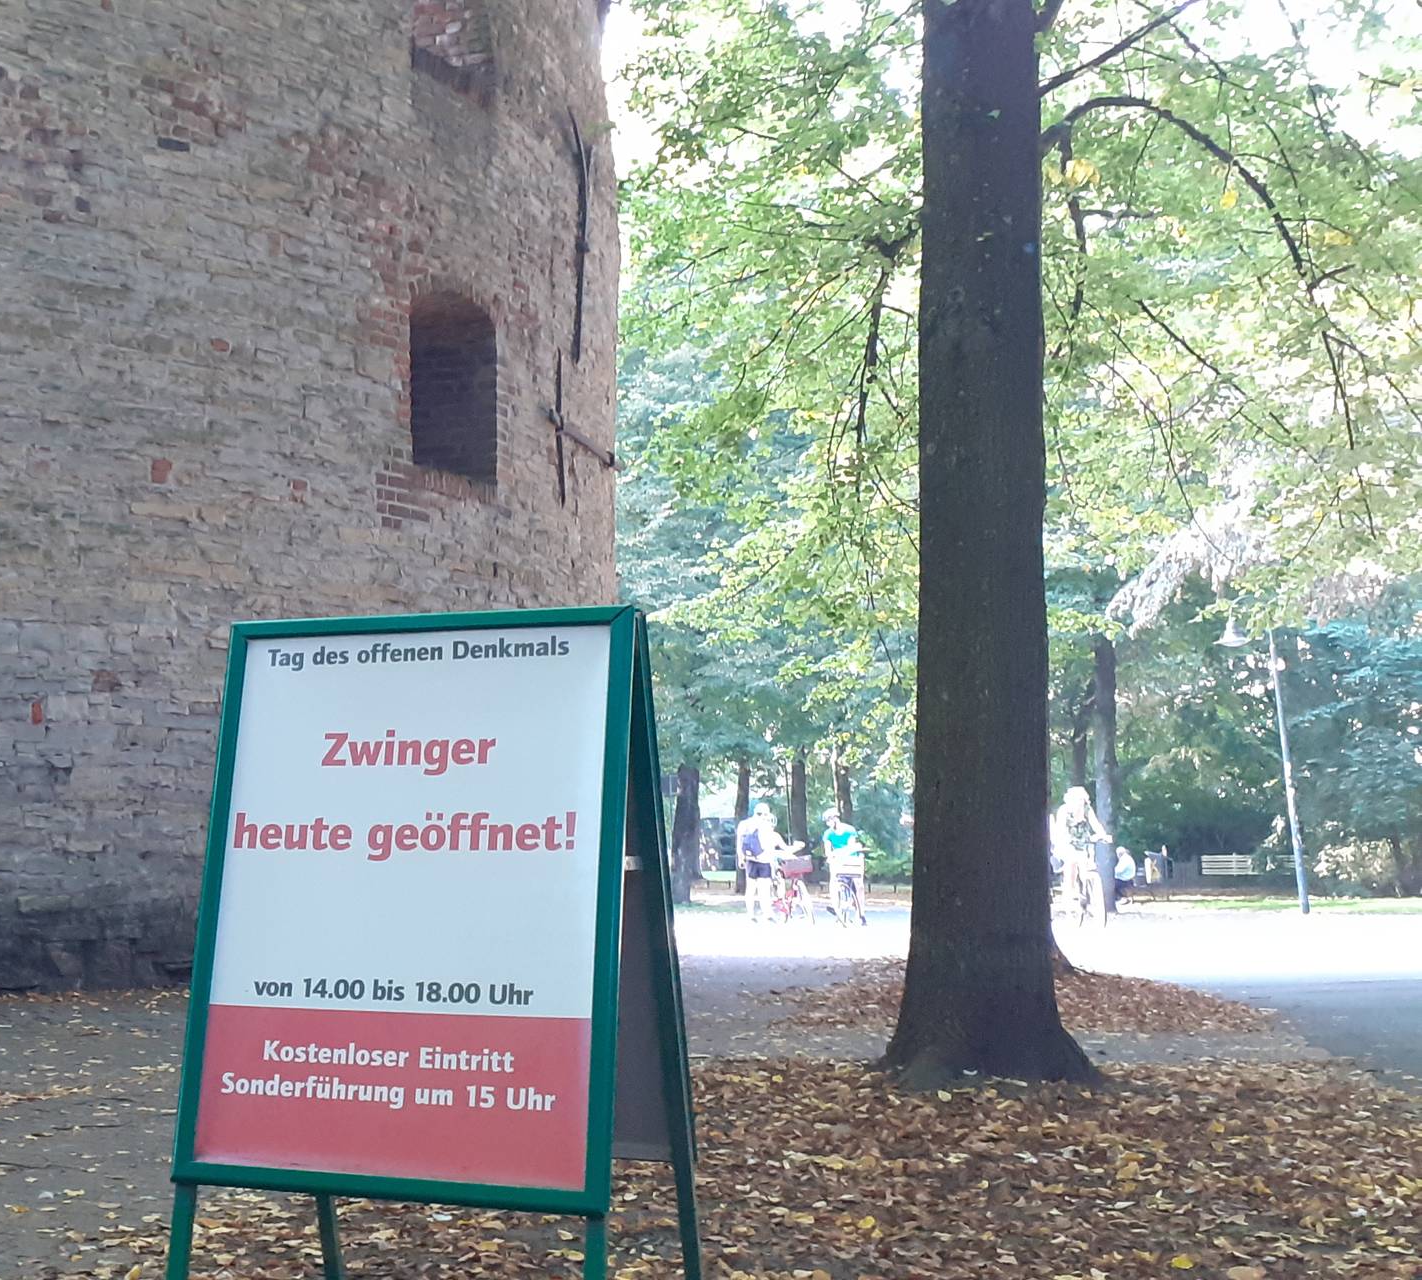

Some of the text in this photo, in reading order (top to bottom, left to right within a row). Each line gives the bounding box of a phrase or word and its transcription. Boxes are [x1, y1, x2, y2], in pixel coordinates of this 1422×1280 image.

[268, 636, 569, 671] Tag des offenen Denkmals
[322, 730, 496, 775] Zwinger
[233, 812, 576, 861] heute geöffnet!
[254, 978, 533, 1005] von 14.00 bis 18.00 Uhr
[264, 1040, 514, 1072] Kostenloser Eintritt
[221, 1072, 555, 1111] Sonderführung um 15 Uhr
